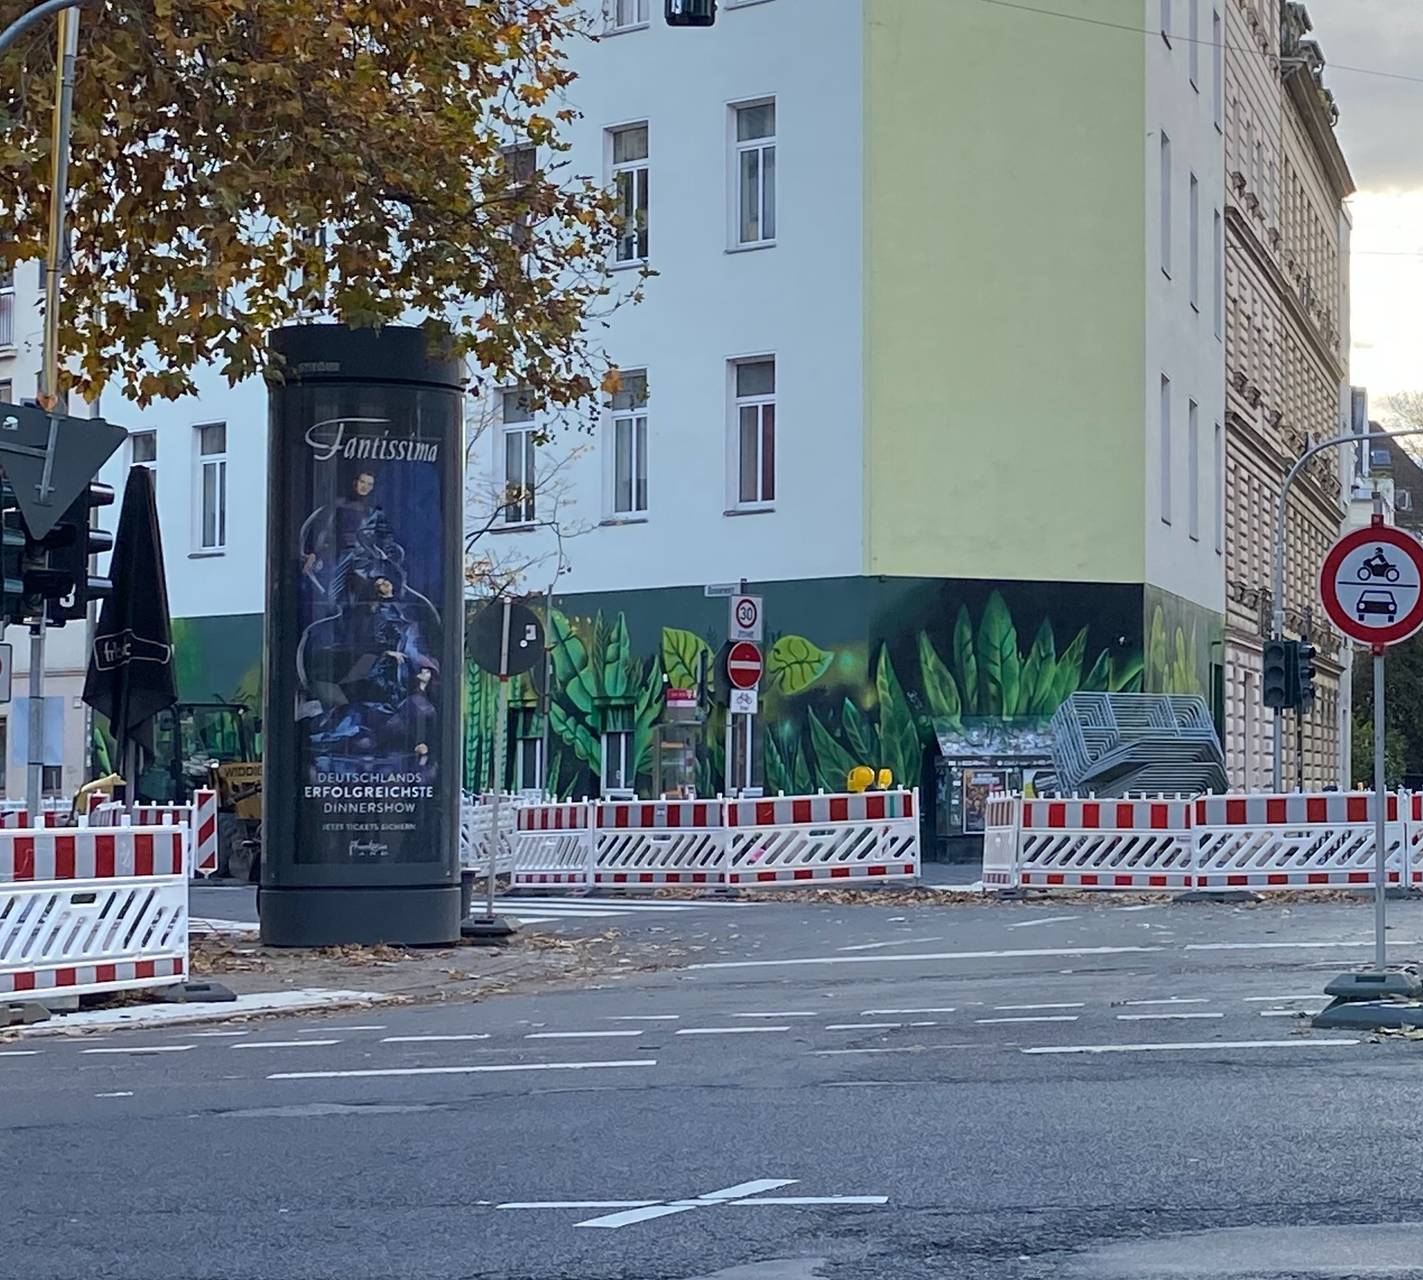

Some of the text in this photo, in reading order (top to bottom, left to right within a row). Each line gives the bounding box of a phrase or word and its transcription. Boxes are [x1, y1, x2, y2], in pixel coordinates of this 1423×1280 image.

[305, 417, 438, 462] Fantissima
[740, 606, 753, 621] 30
[318, 772, 422, 783] DEUTSCHLANDS
[304, 786, 433, 798] ERFOLGREICHSTE
[323, 802, 416, 813] DINNERSHOW
